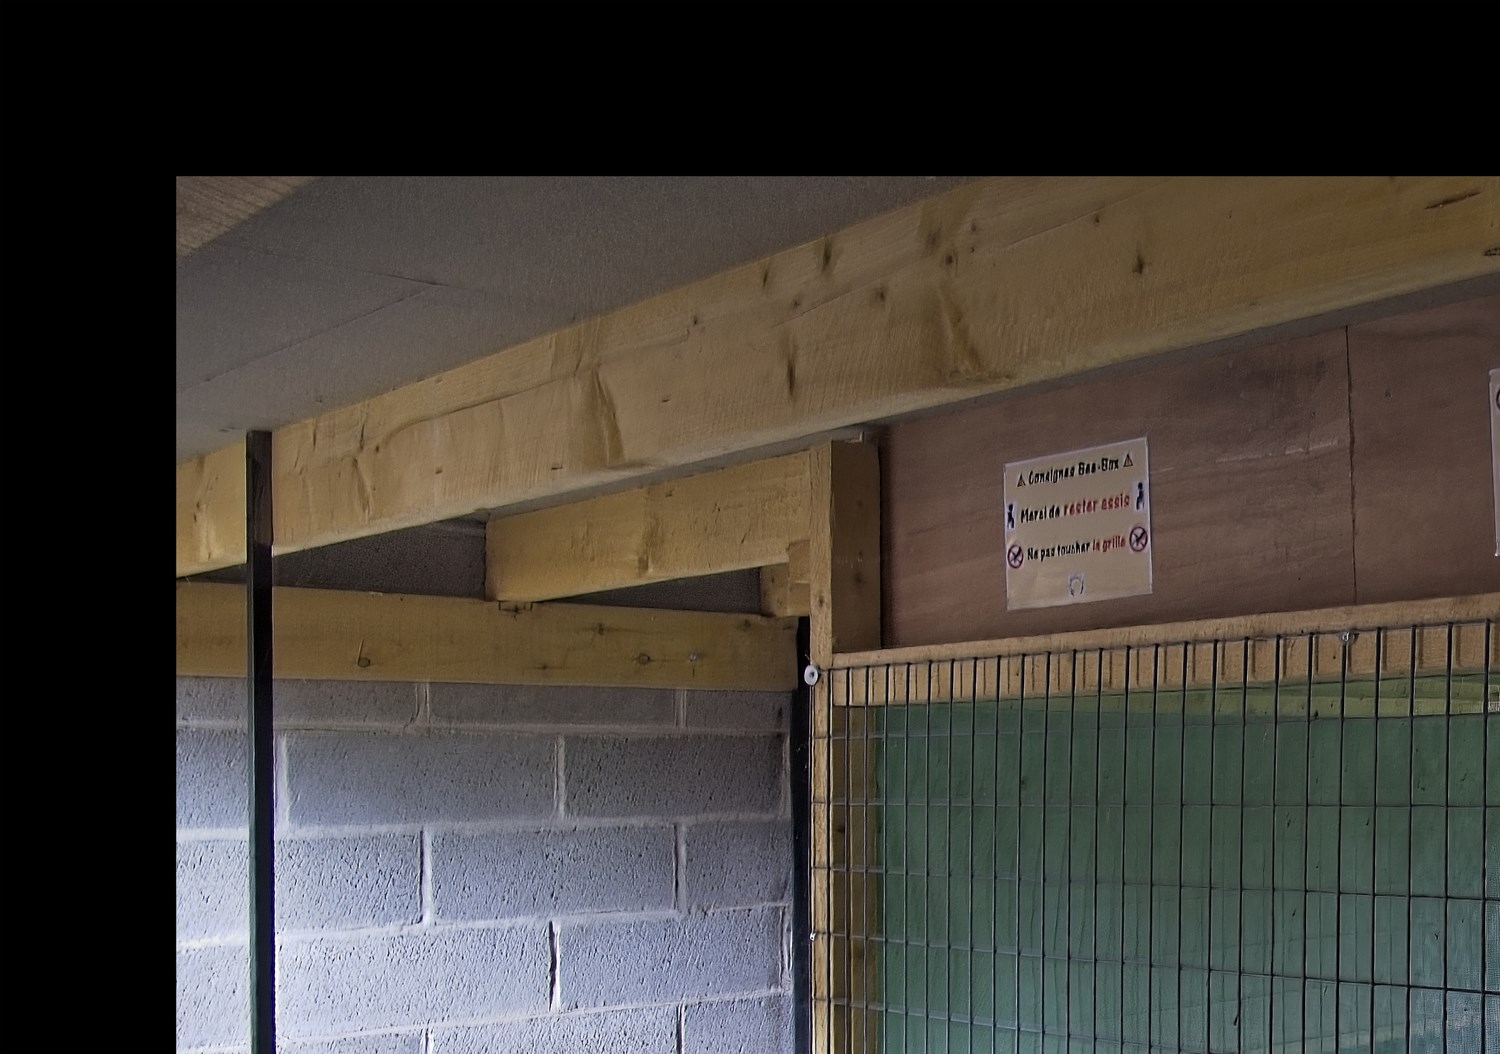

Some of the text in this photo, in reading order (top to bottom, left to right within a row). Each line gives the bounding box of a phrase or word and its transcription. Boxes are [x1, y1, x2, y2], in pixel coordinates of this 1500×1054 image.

[1028, 464, 1075, 486] Consignes
[1020, 493, 1130, 523] Merci de rester assis
[1027, 547, 1038, 560] Ne
[1040, 548, 1055, 562] pas
[1057, 541, 1090, 557] toucher
[1102, 535, 1125, 553] grille
